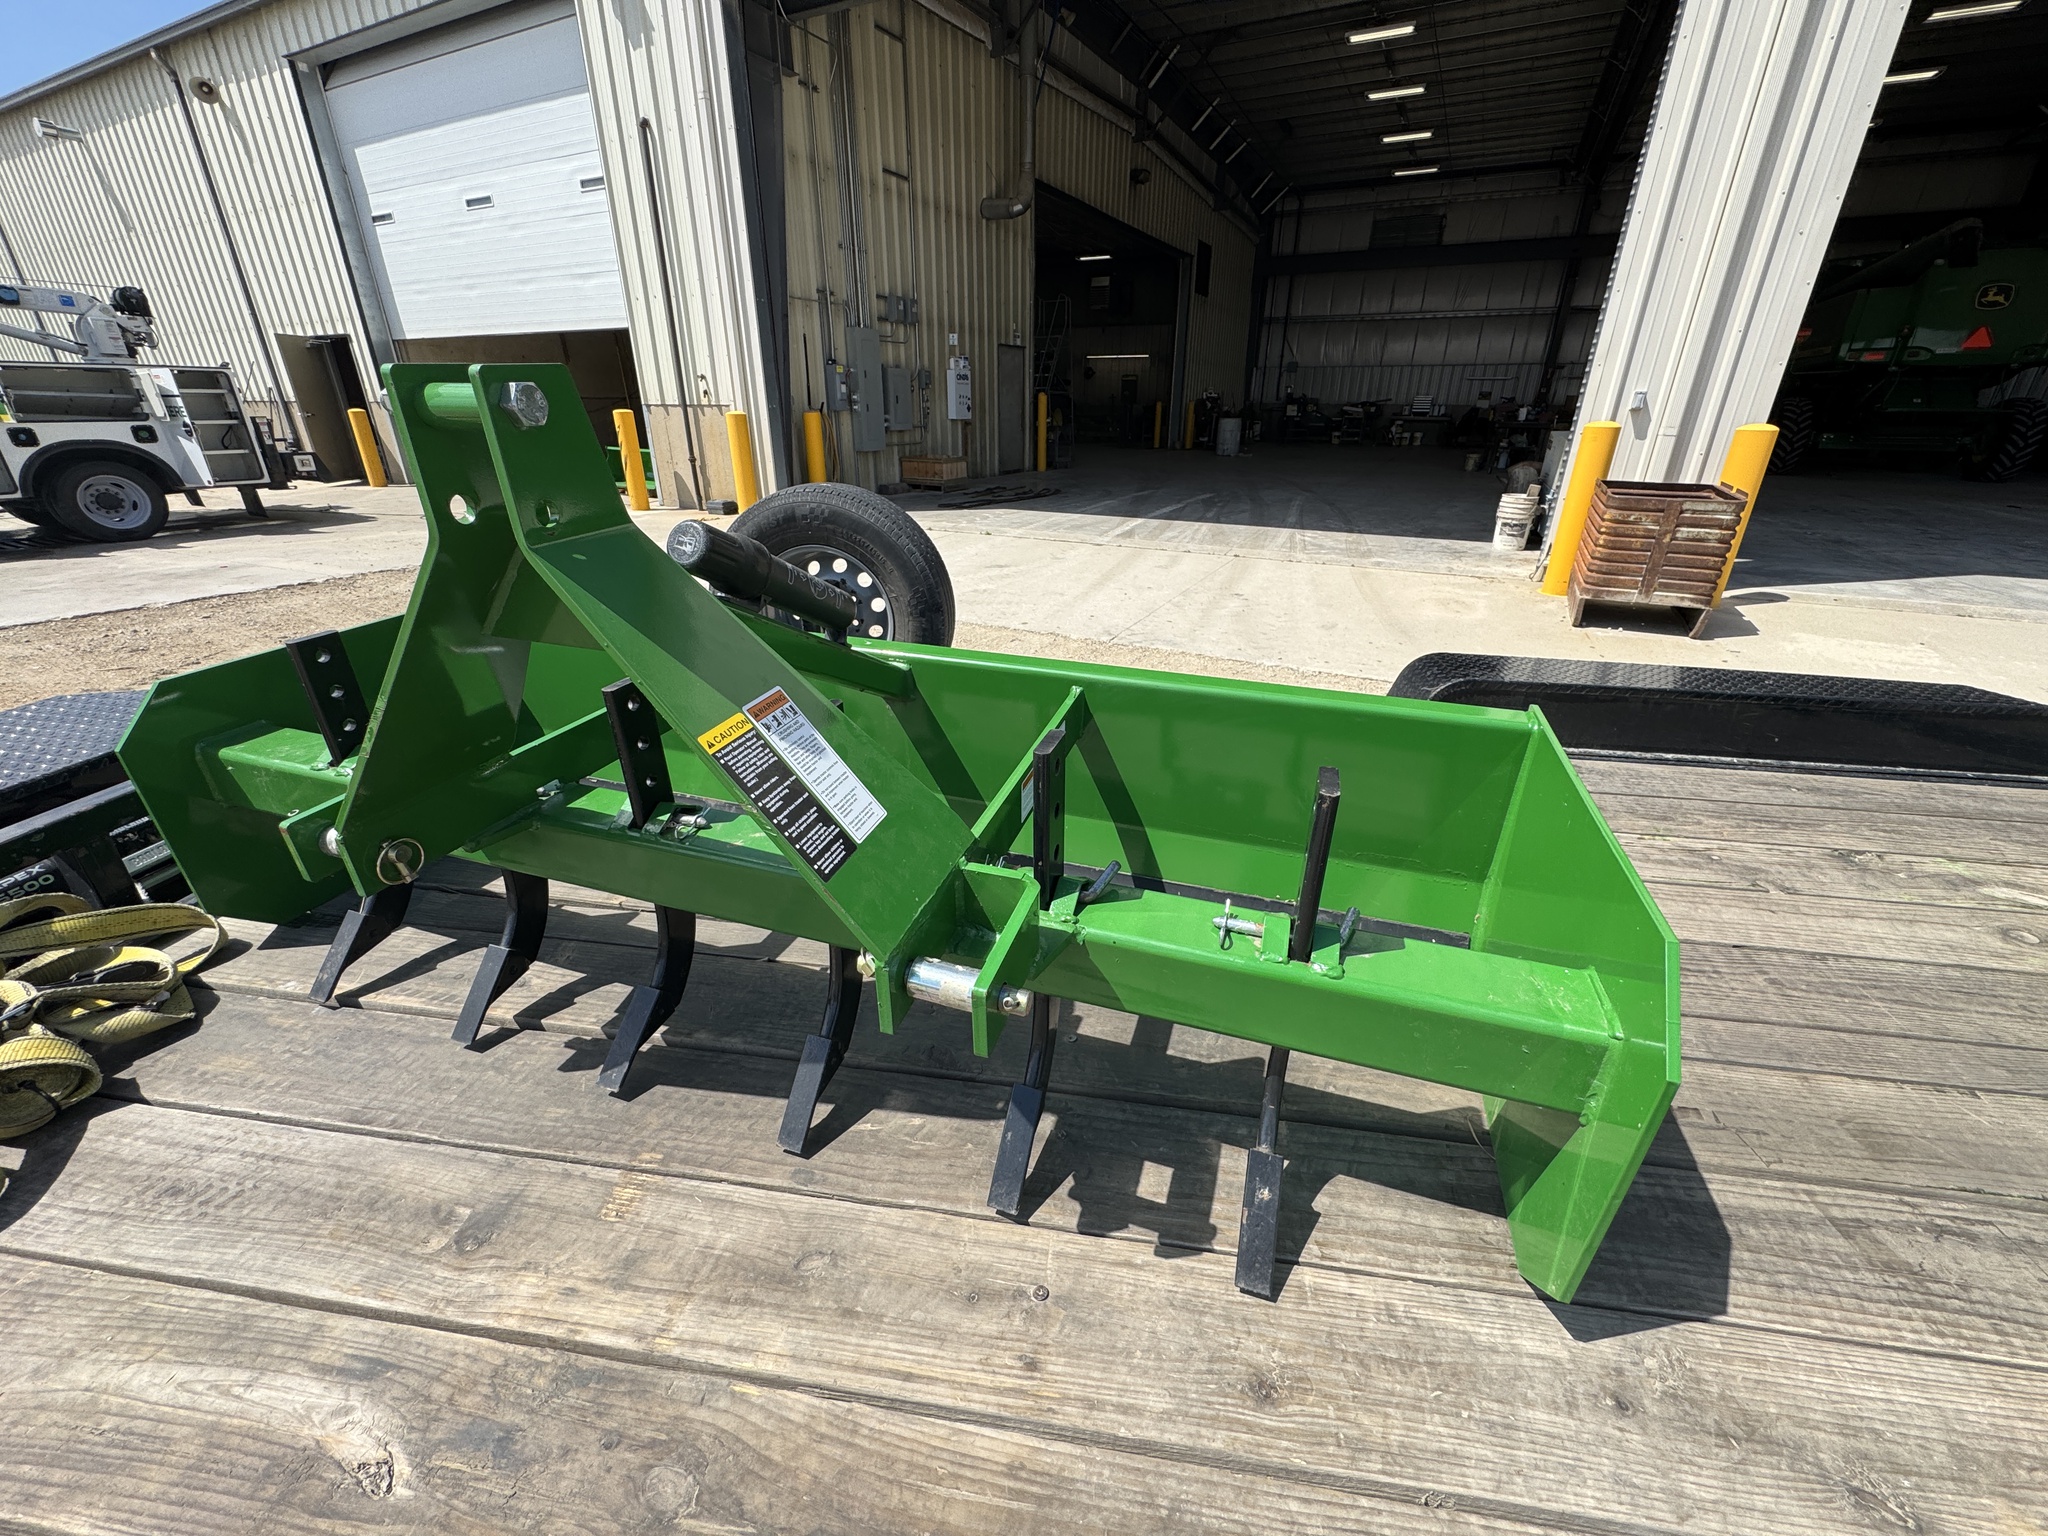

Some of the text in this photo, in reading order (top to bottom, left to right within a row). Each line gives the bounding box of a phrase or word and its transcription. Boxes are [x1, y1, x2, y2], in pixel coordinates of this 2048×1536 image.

[756, 694, 786, 714] WARNING
[714, 718, 750, 744] CAUTION
[0, 864, 46, 889] PEX
